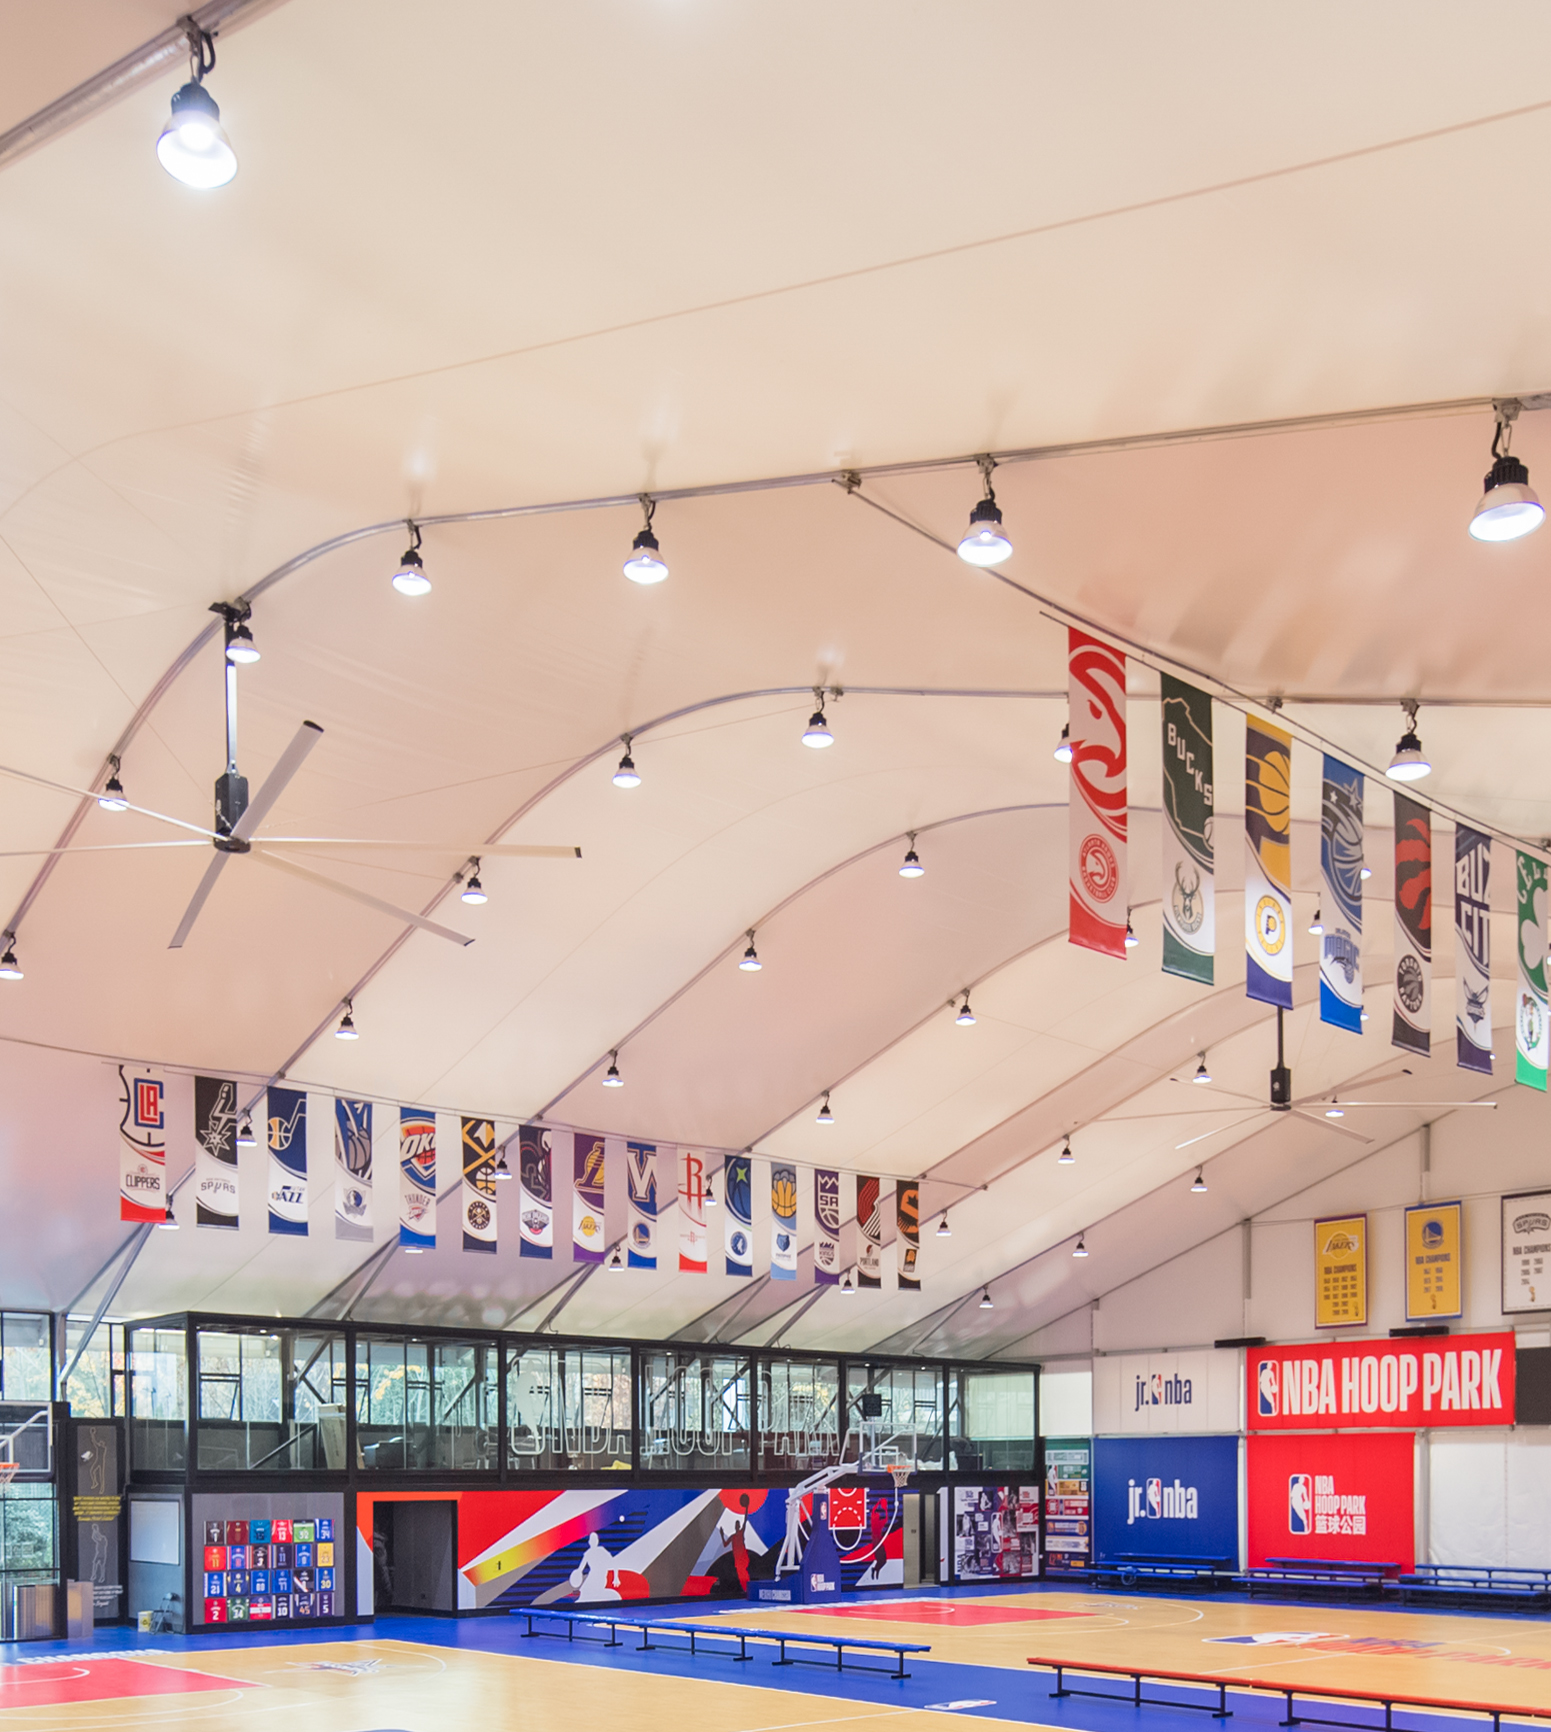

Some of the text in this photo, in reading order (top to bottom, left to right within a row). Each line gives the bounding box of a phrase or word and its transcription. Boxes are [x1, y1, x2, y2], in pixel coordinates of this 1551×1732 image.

[1167, 722, 1213, 806] BUCKS
[126, 1174, 160, 1190] CLIPPERS
[201, 1181, 236, 1194] SPURS
[1516, 1217, 1549, 1231] SPURS
[1513, 1243, 1551, 1255] NBA CHAMPIONS
[1282, 1348, 1503, 1415] NBA HOOP PARK
[1135, 1373, 1192, 1411] jr. nba
[1314, 1475, 1334, 1495] NBA
[1127, 1478, 1198, 1524] jr. nba
[1314, 1495, 1366, 1515] HOOP PARK
[1314, 1515, 1367, 1535] 篮球公园
[279, 1531, 286, 1541] 13
[210, 1585, 220, 1595] 21
[321, 1579, 331, 1589] 30
[212, 1610, 219, 1620] 2
[277, 1606, 288, 1617] 10
[323, 1604, 329, 1614] 5
